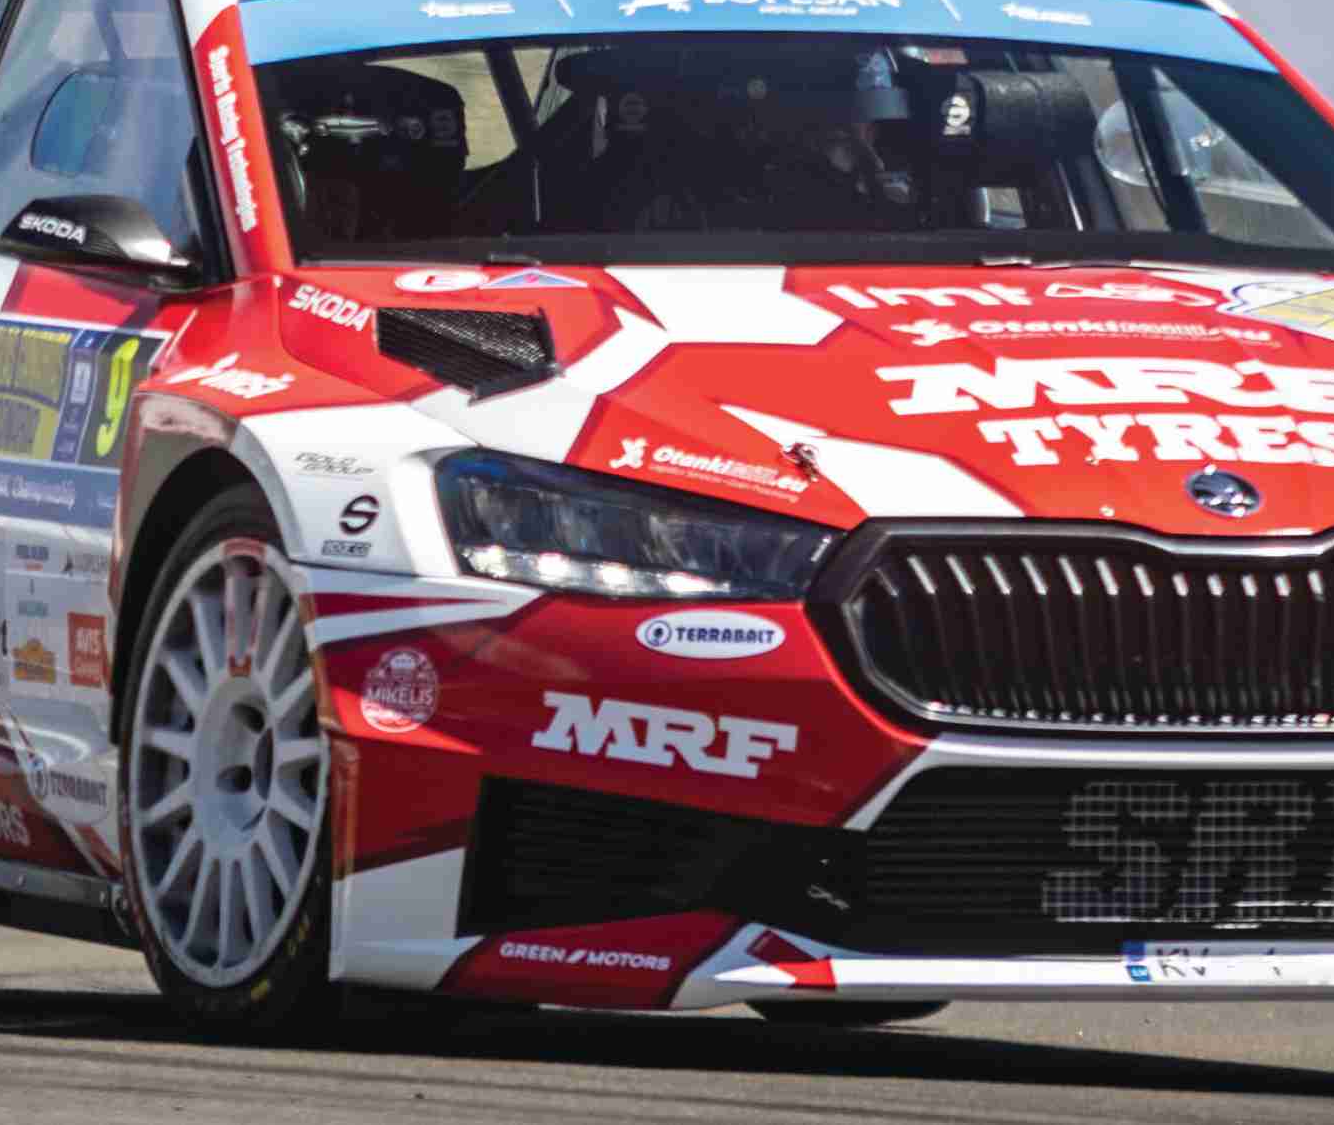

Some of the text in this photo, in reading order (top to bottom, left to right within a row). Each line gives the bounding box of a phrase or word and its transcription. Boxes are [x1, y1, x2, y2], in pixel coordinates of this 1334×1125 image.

[531, 689, 798, 779] MRF
[499, 941, 671, 971] GREEN MOTORS
